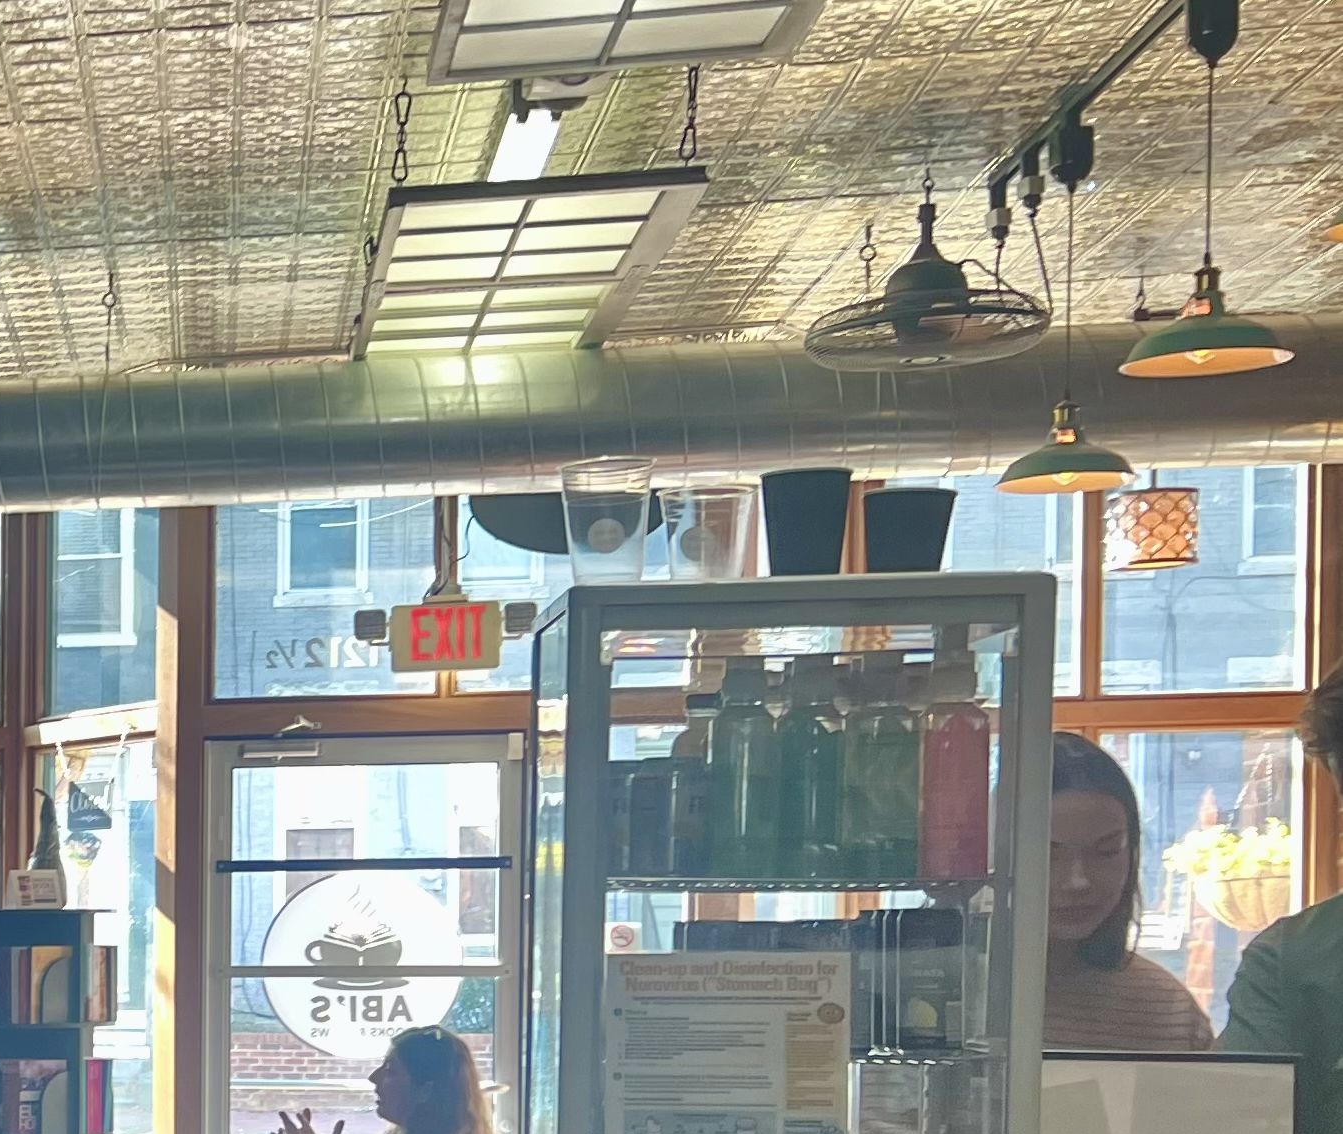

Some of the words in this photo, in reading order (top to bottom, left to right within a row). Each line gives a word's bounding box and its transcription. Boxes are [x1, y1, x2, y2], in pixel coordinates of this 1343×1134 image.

[409, 606, 487, 662] EXIT
[619, 960, 686, 979] Clean-up
[690, 960, 720, 976] and
[723, 960, 814, 976] Disinfection
[816, 959, 839, 976] for
[625, 977, 701, 992] Norovirus
